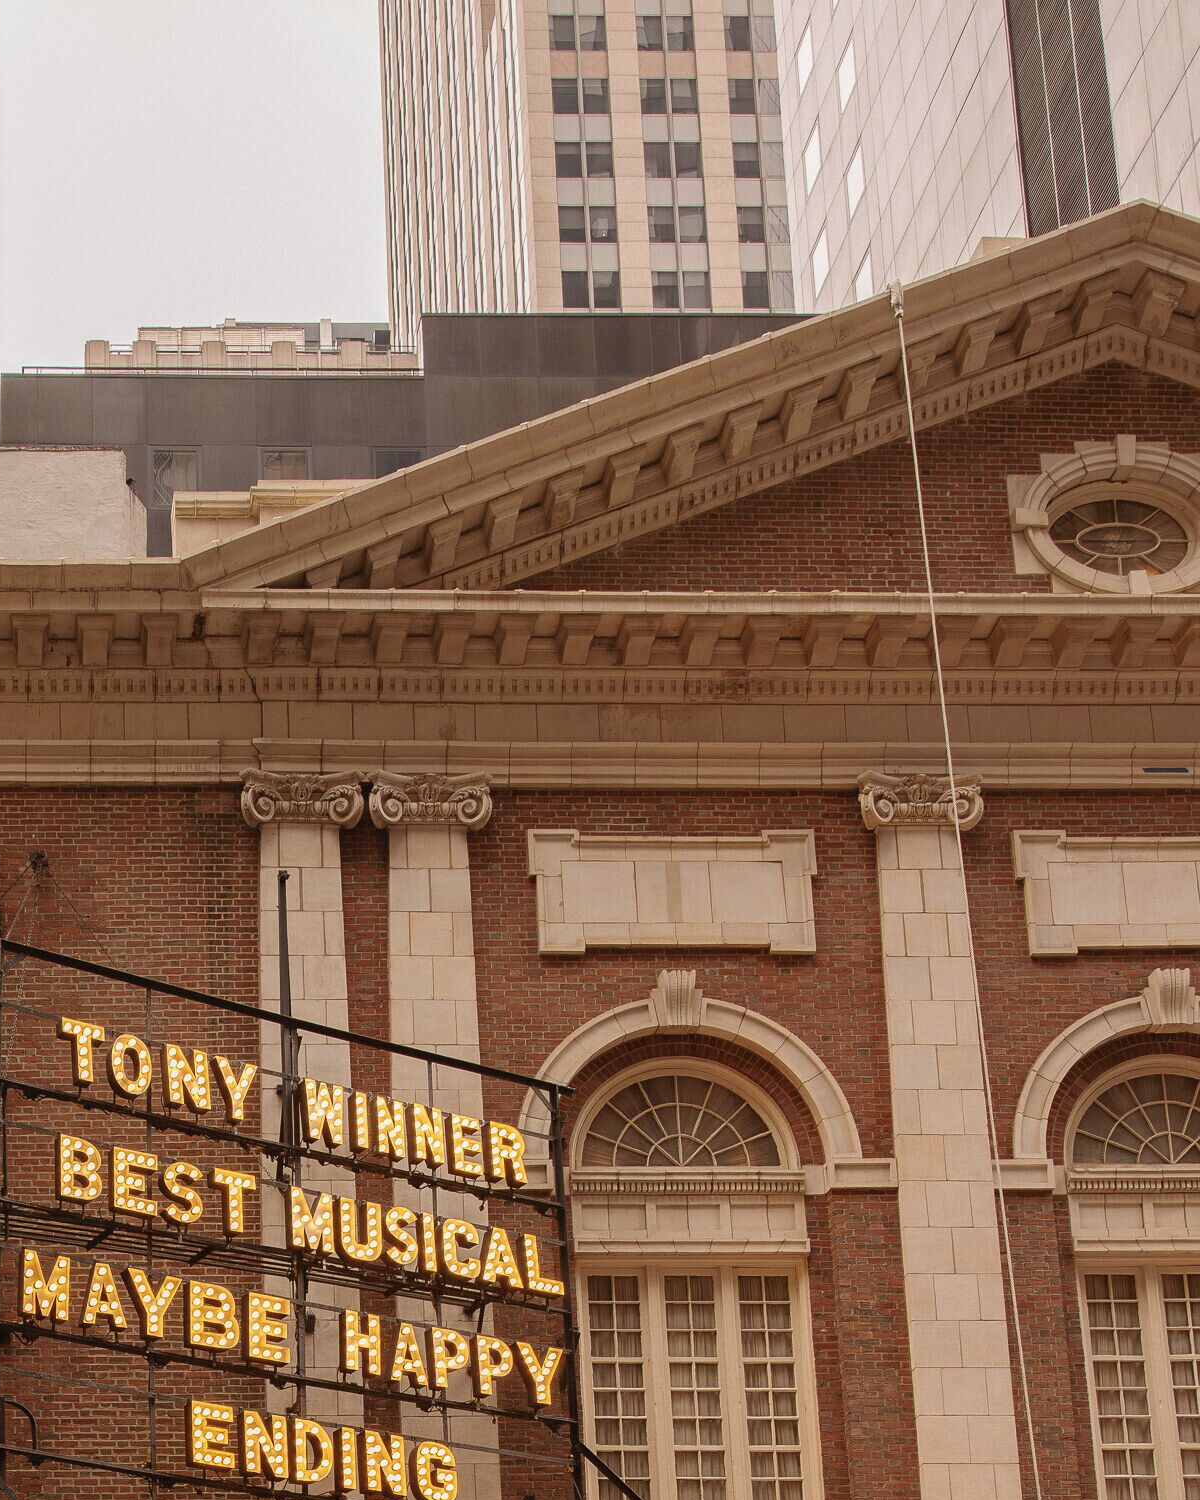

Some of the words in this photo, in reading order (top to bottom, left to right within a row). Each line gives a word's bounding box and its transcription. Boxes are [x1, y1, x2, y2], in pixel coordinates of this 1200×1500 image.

[57, 1017, 258, 1124] TONY
[300, 1077, 528, 1189] WINNER
[55, 1132, 257, 1239] BEST
[285, 1185, 566, 1297] MUSICAL
[19, 1249, 291, 1367] MAYBE
[339, 1310, 563, 1407] HAPPY
